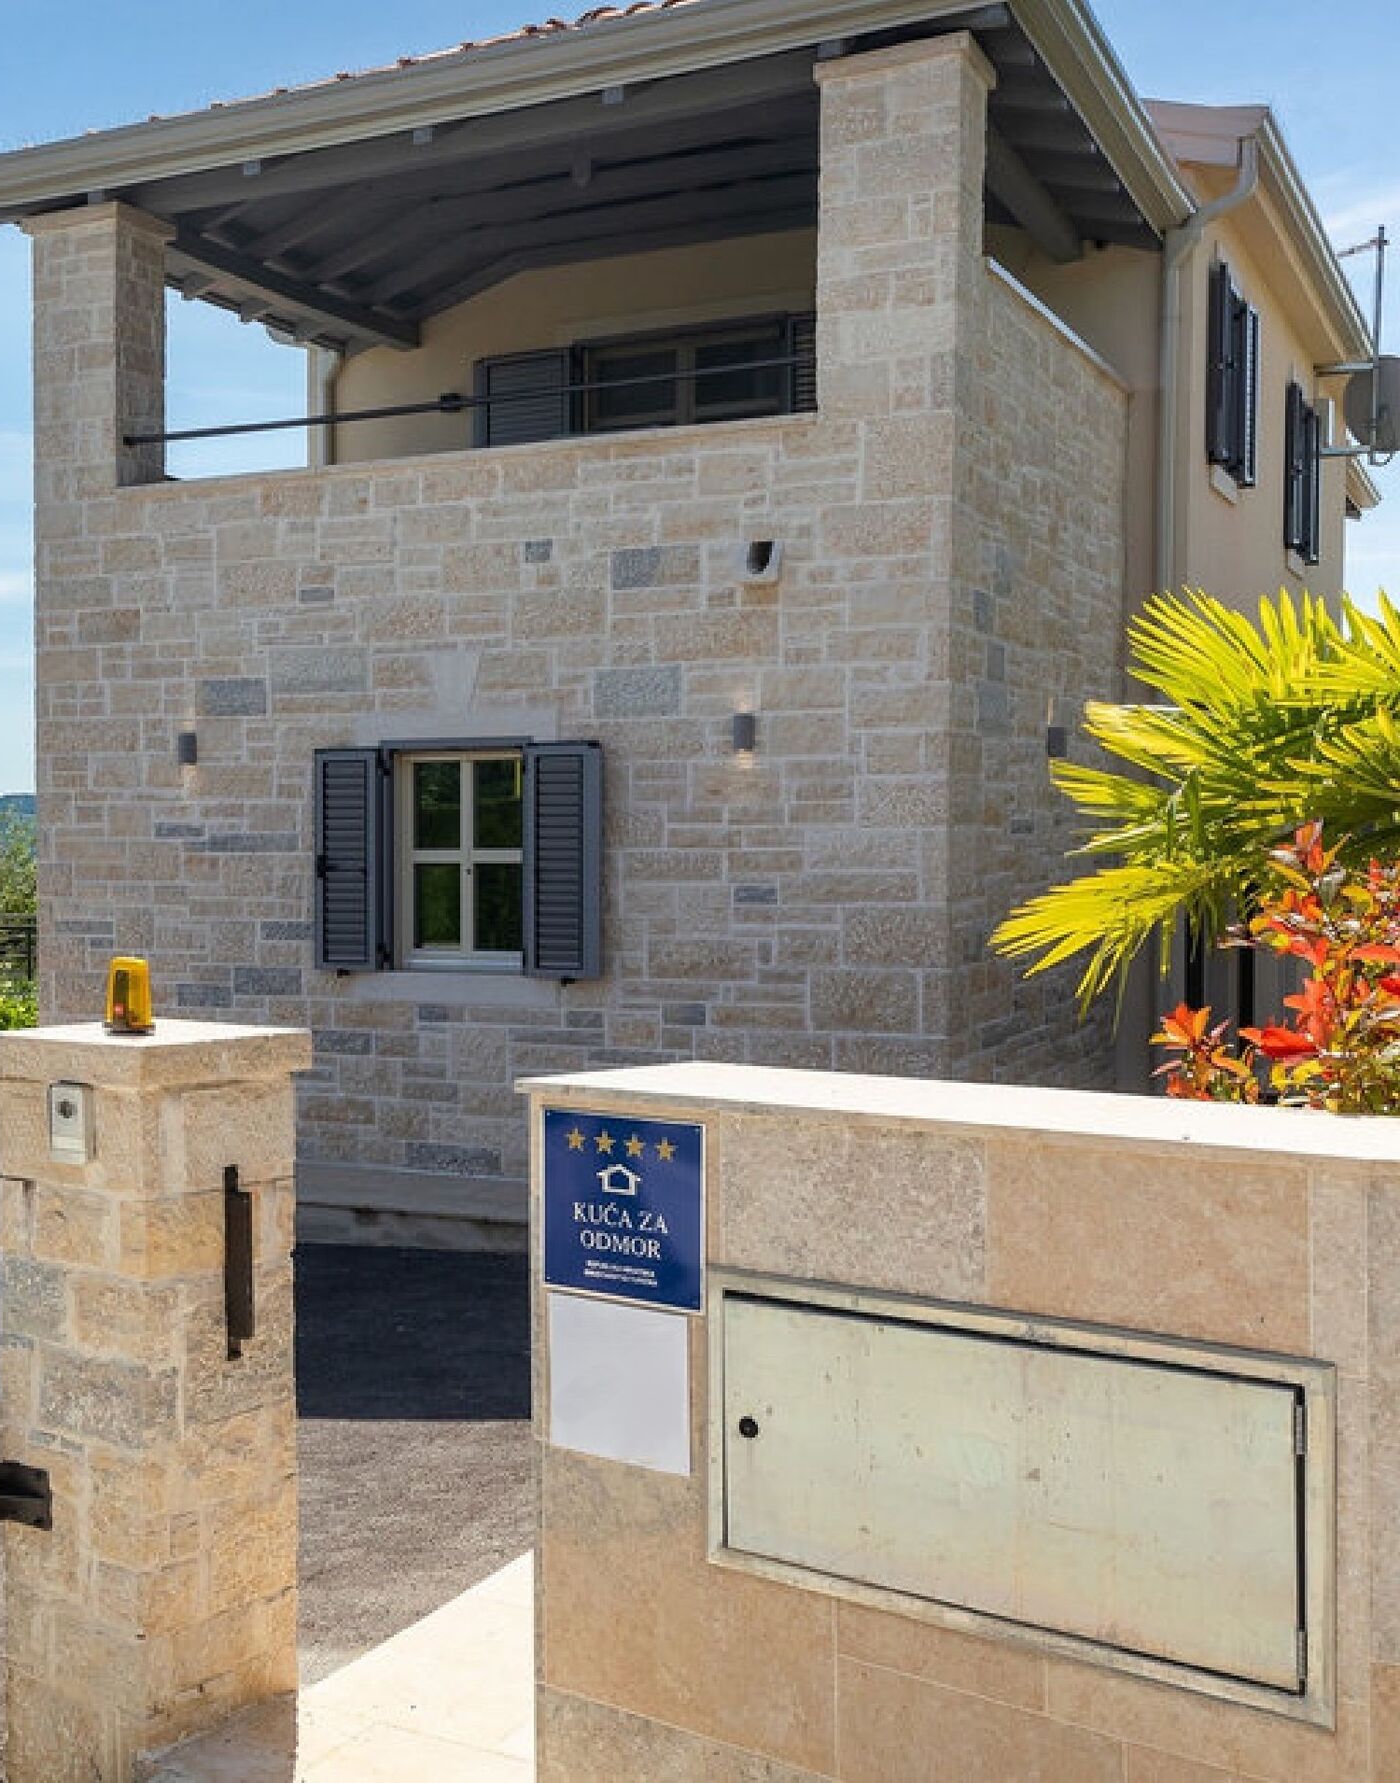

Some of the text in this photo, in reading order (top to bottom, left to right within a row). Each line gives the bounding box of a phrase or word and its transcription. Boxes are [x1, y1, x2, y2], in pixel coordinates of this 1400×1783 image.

[573, 1202, 668, 1233] KUĆA ZA
[580, 1230, 661, 1260] ODMOR
